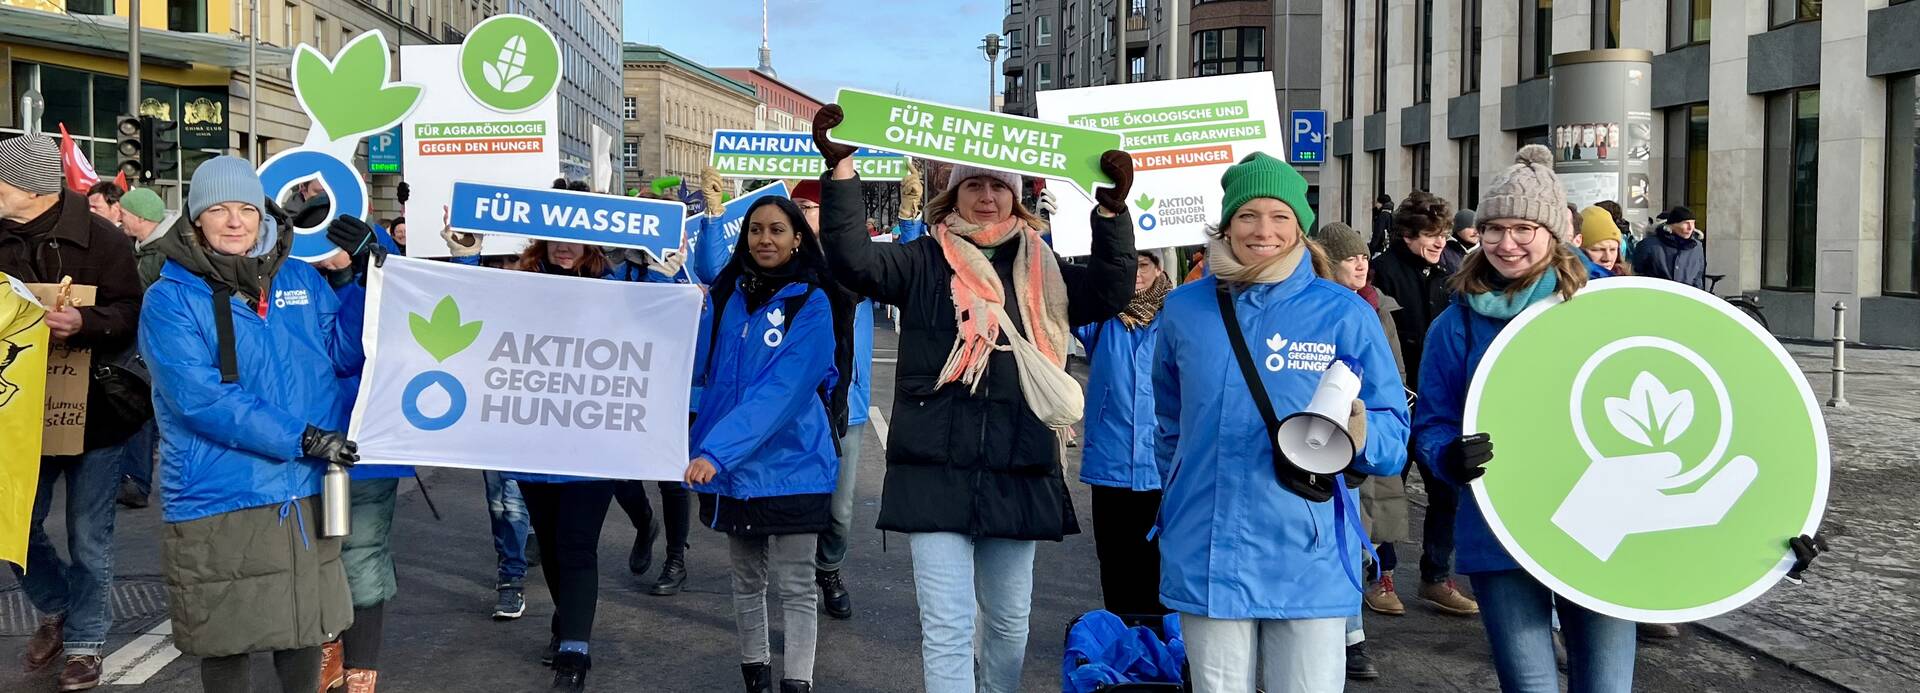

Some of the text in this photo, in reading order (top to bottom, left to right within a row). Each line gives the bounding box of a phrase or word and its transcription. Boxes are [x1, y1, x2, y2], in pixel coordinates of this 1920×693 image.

[1101, 116, 1120, 127] DIE
[1124, 108, 1212, 125] ÖKOLOGISCHE
[1215, 106, 1244, 117] UND
[418, 123, 543, 136] FÜR AGRARÖKOLOGIE
[889, 105, 1063, 149] FÜR EINE WELT
[1122, 125, 1261, 147] RECHTE AGRARWENDE
[1295, 119, 1311, 143] P
[380, 134, 391, 152] P
[422, 141, 540, 153] GEGEN DEN HUNGER
[719, 135, 819, 153] NAHRUN
[885, 126, 1067, 170] OHNE HUNGER
[716, 155, 904, 175] MENSCHEECHT
[1147, 155, 1172, 167] DEN
[1175, 150, 1228, 164] HUNGER
[1159, 195, 1204, 208] AKTION
[1159, 205, 1205, 216] GEGEN DEN
[475, 192, 660, 237] FÜR WASSER
[1160, 213, 1206, 226] HUNGER
[488, 331, 653, 372] AKTION
[1288, 342, 1336, 354] AKTION
[1288, 352, 1317, 360] GEGEN
[47, 365, 77, 376] ern
[1287, 360, 1329, 371] HUNGE
[484, 367, 649, 398] GEGEN DEN
[45, 412, 85, 427] sität
[481, 394, 647, 432] HUNGER
